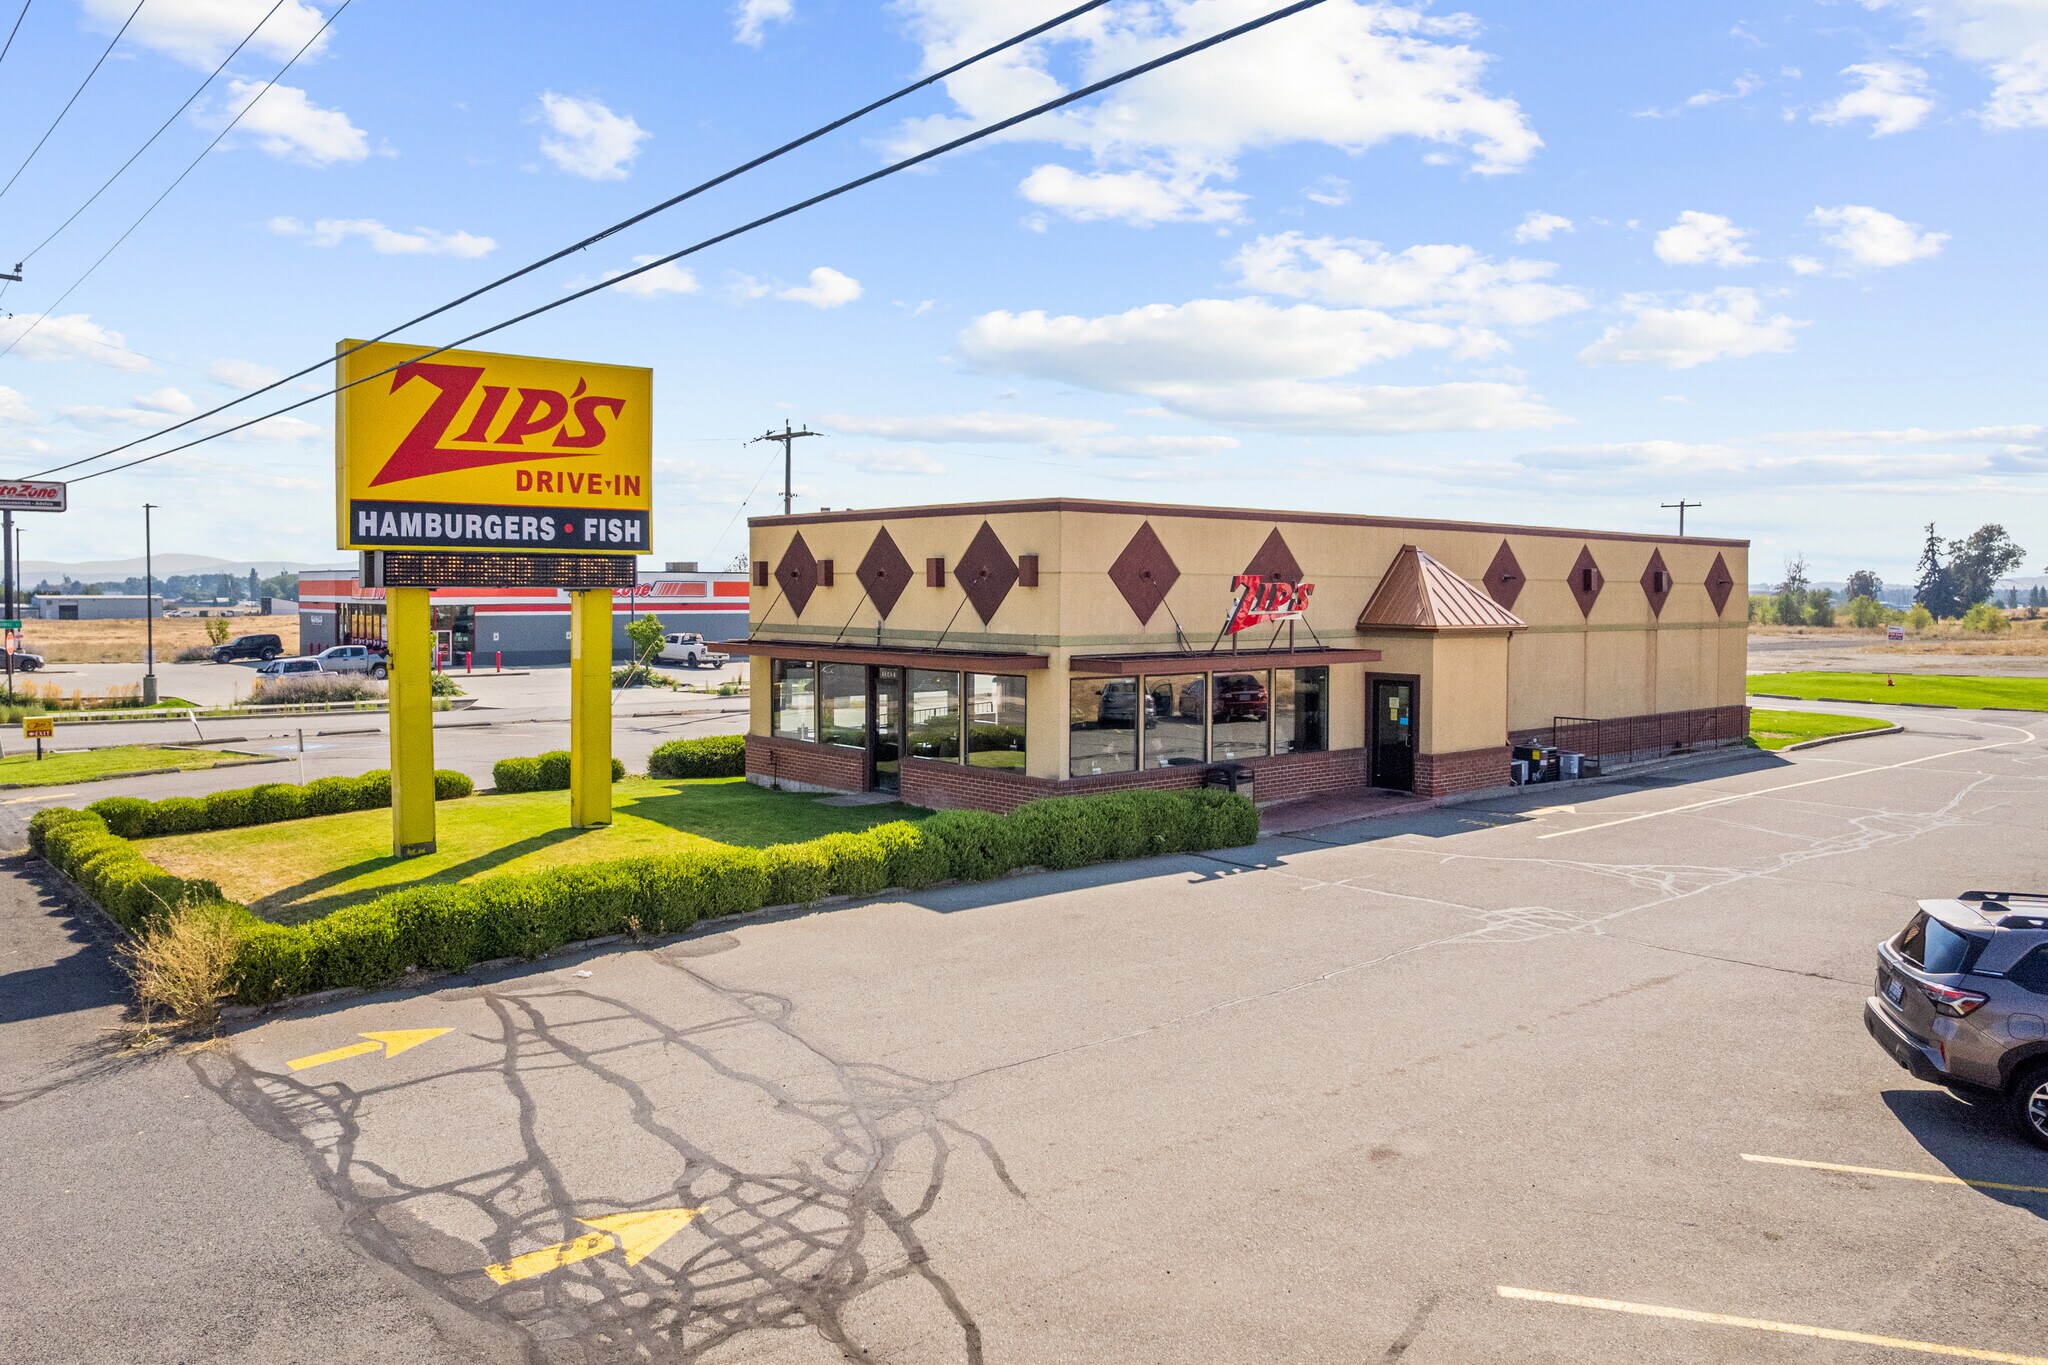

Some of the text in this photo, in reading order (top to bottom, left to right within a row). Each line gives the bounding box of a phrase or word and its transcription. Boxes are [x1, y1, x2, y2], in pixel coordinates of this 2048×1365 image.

[368, 362, 626, 487] ZIP'S
[358, 511, 641, 542] HAMBURGERS FISH
[1224, 575, 1316, 635] ZIP'S
